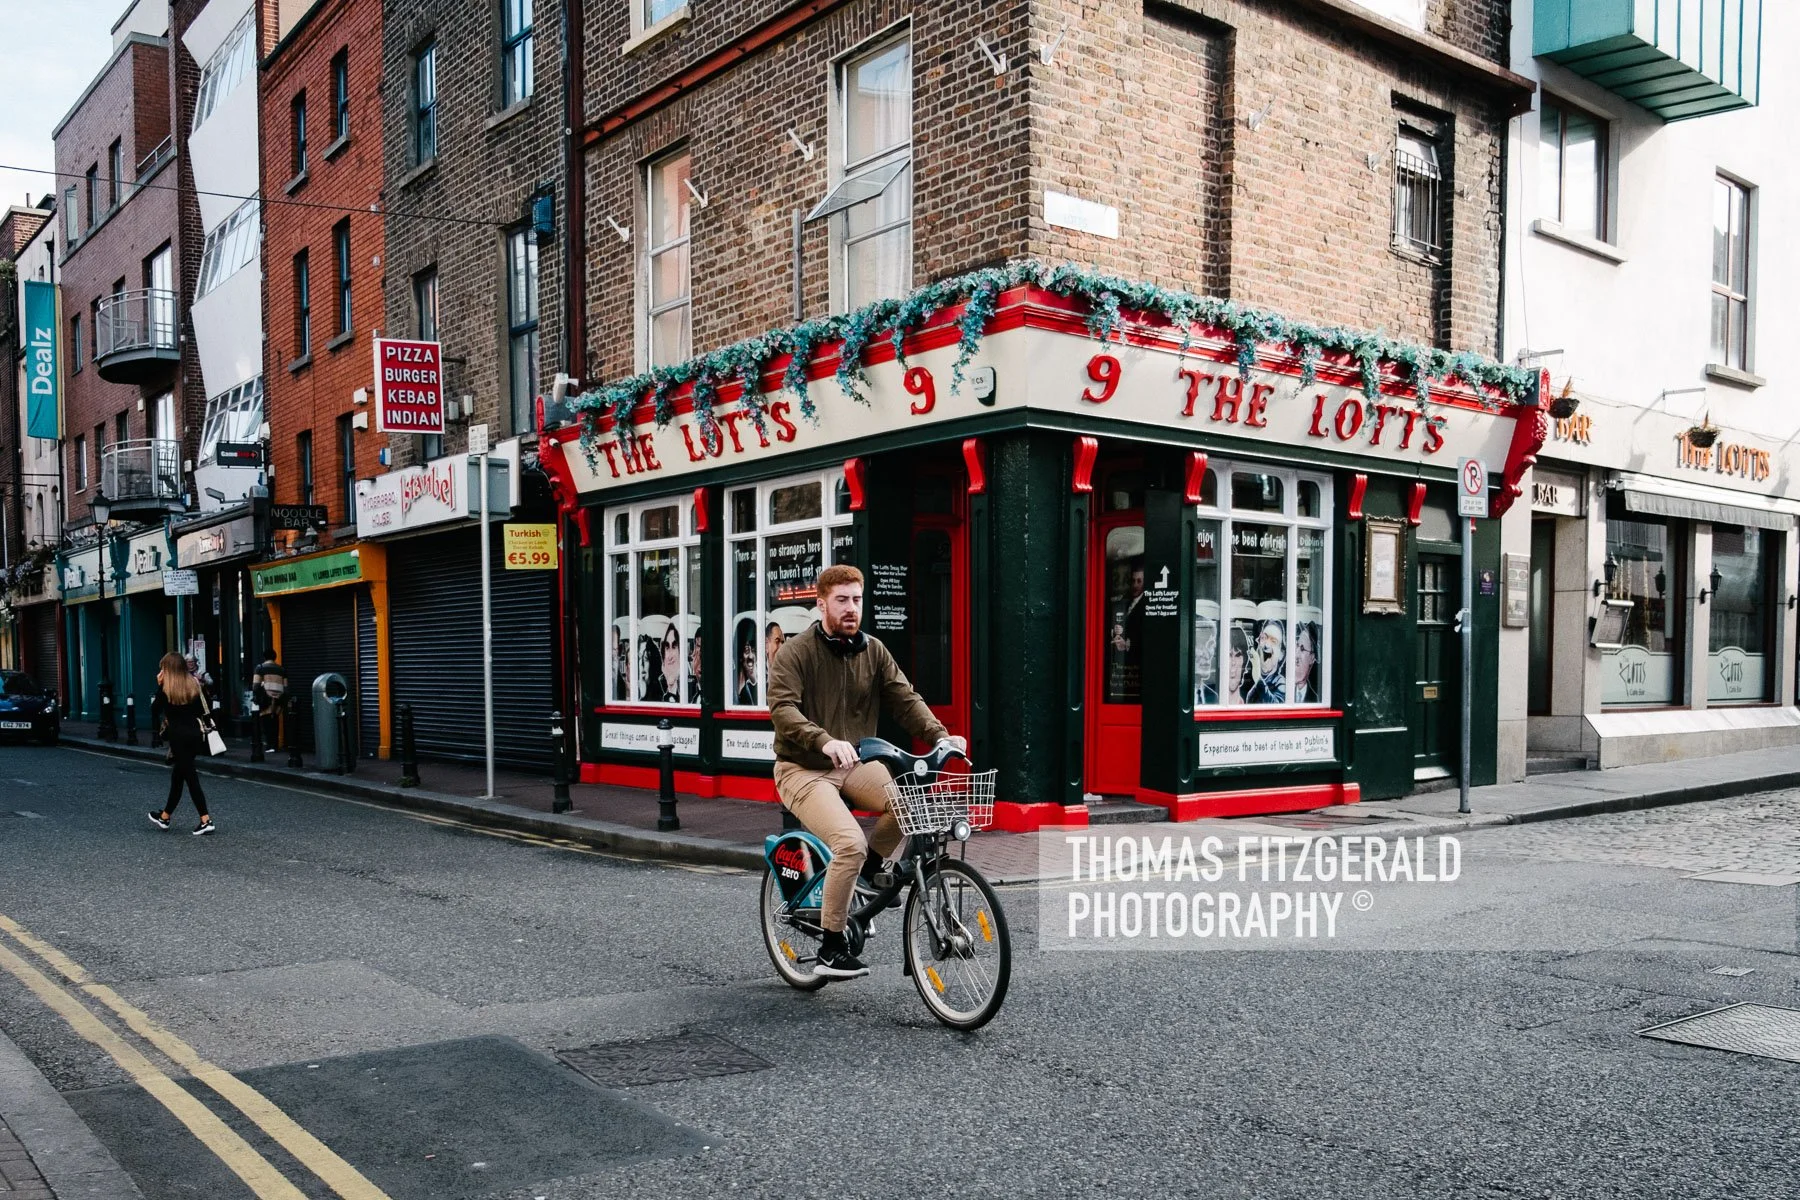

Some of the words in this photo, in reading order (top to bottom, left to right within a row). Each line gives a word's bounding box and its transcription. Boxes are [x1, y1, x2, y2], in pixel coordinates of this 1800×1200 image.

[31, 327, 52, 395] Dealz
[386, 346, 435, 364] PIZZA
[384, 368, 438, 384] BURGER
[388, 389, 436, 406] KEBAB
[1080, 354, 1123, 404] 9
[1178, 368, 1275, 428] THE
[1307, 394, 1448, 454] LOTTS
[386, 410, 440, 426] INDIAN
[596, 432, 662, 478] THE
[680, 401, 798, 462] LOTTS
[904, 366, 936, 415] 9
[1556, 412, 1592, 442] BAR
[1677, 432, 1712, 467] THE
[1717, 440, 1770, 480] LOTTS
[1537, 483, 1558, 505] BAR
[271, 508, 324, 519] NOODLE
[284, 518, 310, 528] BAR
[508, 529, 542, 538] Turkish
[1198, 528, 1214, 548] njoy
[1231, 532, 1240, 546] he
[1241, 530, 1258, 547] best
[1259, 533, 1269, 548] of
[1270, 533, 1286, 549] Irish
[734, 549, 750, 562] There
[769, 548, 777, 558] no
[778, 543, 806, 560] strangers
[807, 538, 821, 553] here
[832, 537, 844, 550] just
[508, 552, 550, 565] €5.99
[615, 561, 629, 573] Grea
[766, 571, 777, 586] you
[779, 564, 801, 580] haven't
[802, 564, 814, 577] met
[605, 729, 617, 740] Great
[620, 731, 634, 744] things
[636, 733, 648, 741] come
[726, 738, 735, 748] The
[737, 738, 749, 748] truth
[751, 742, 767, 750] comes
[1203, 743, 1240, 756] Experience
[1242, 742, 1251, 752] the
[1254, 741, 1268, 751] best
[1270, 740, 1277, 751] of
[1278, 740, 1293, 750] Irish
[1296, 741, 1302, 750] at
[1304, 735, 1328, 746] Dublin's
[782, 866, 799, 880] zero
